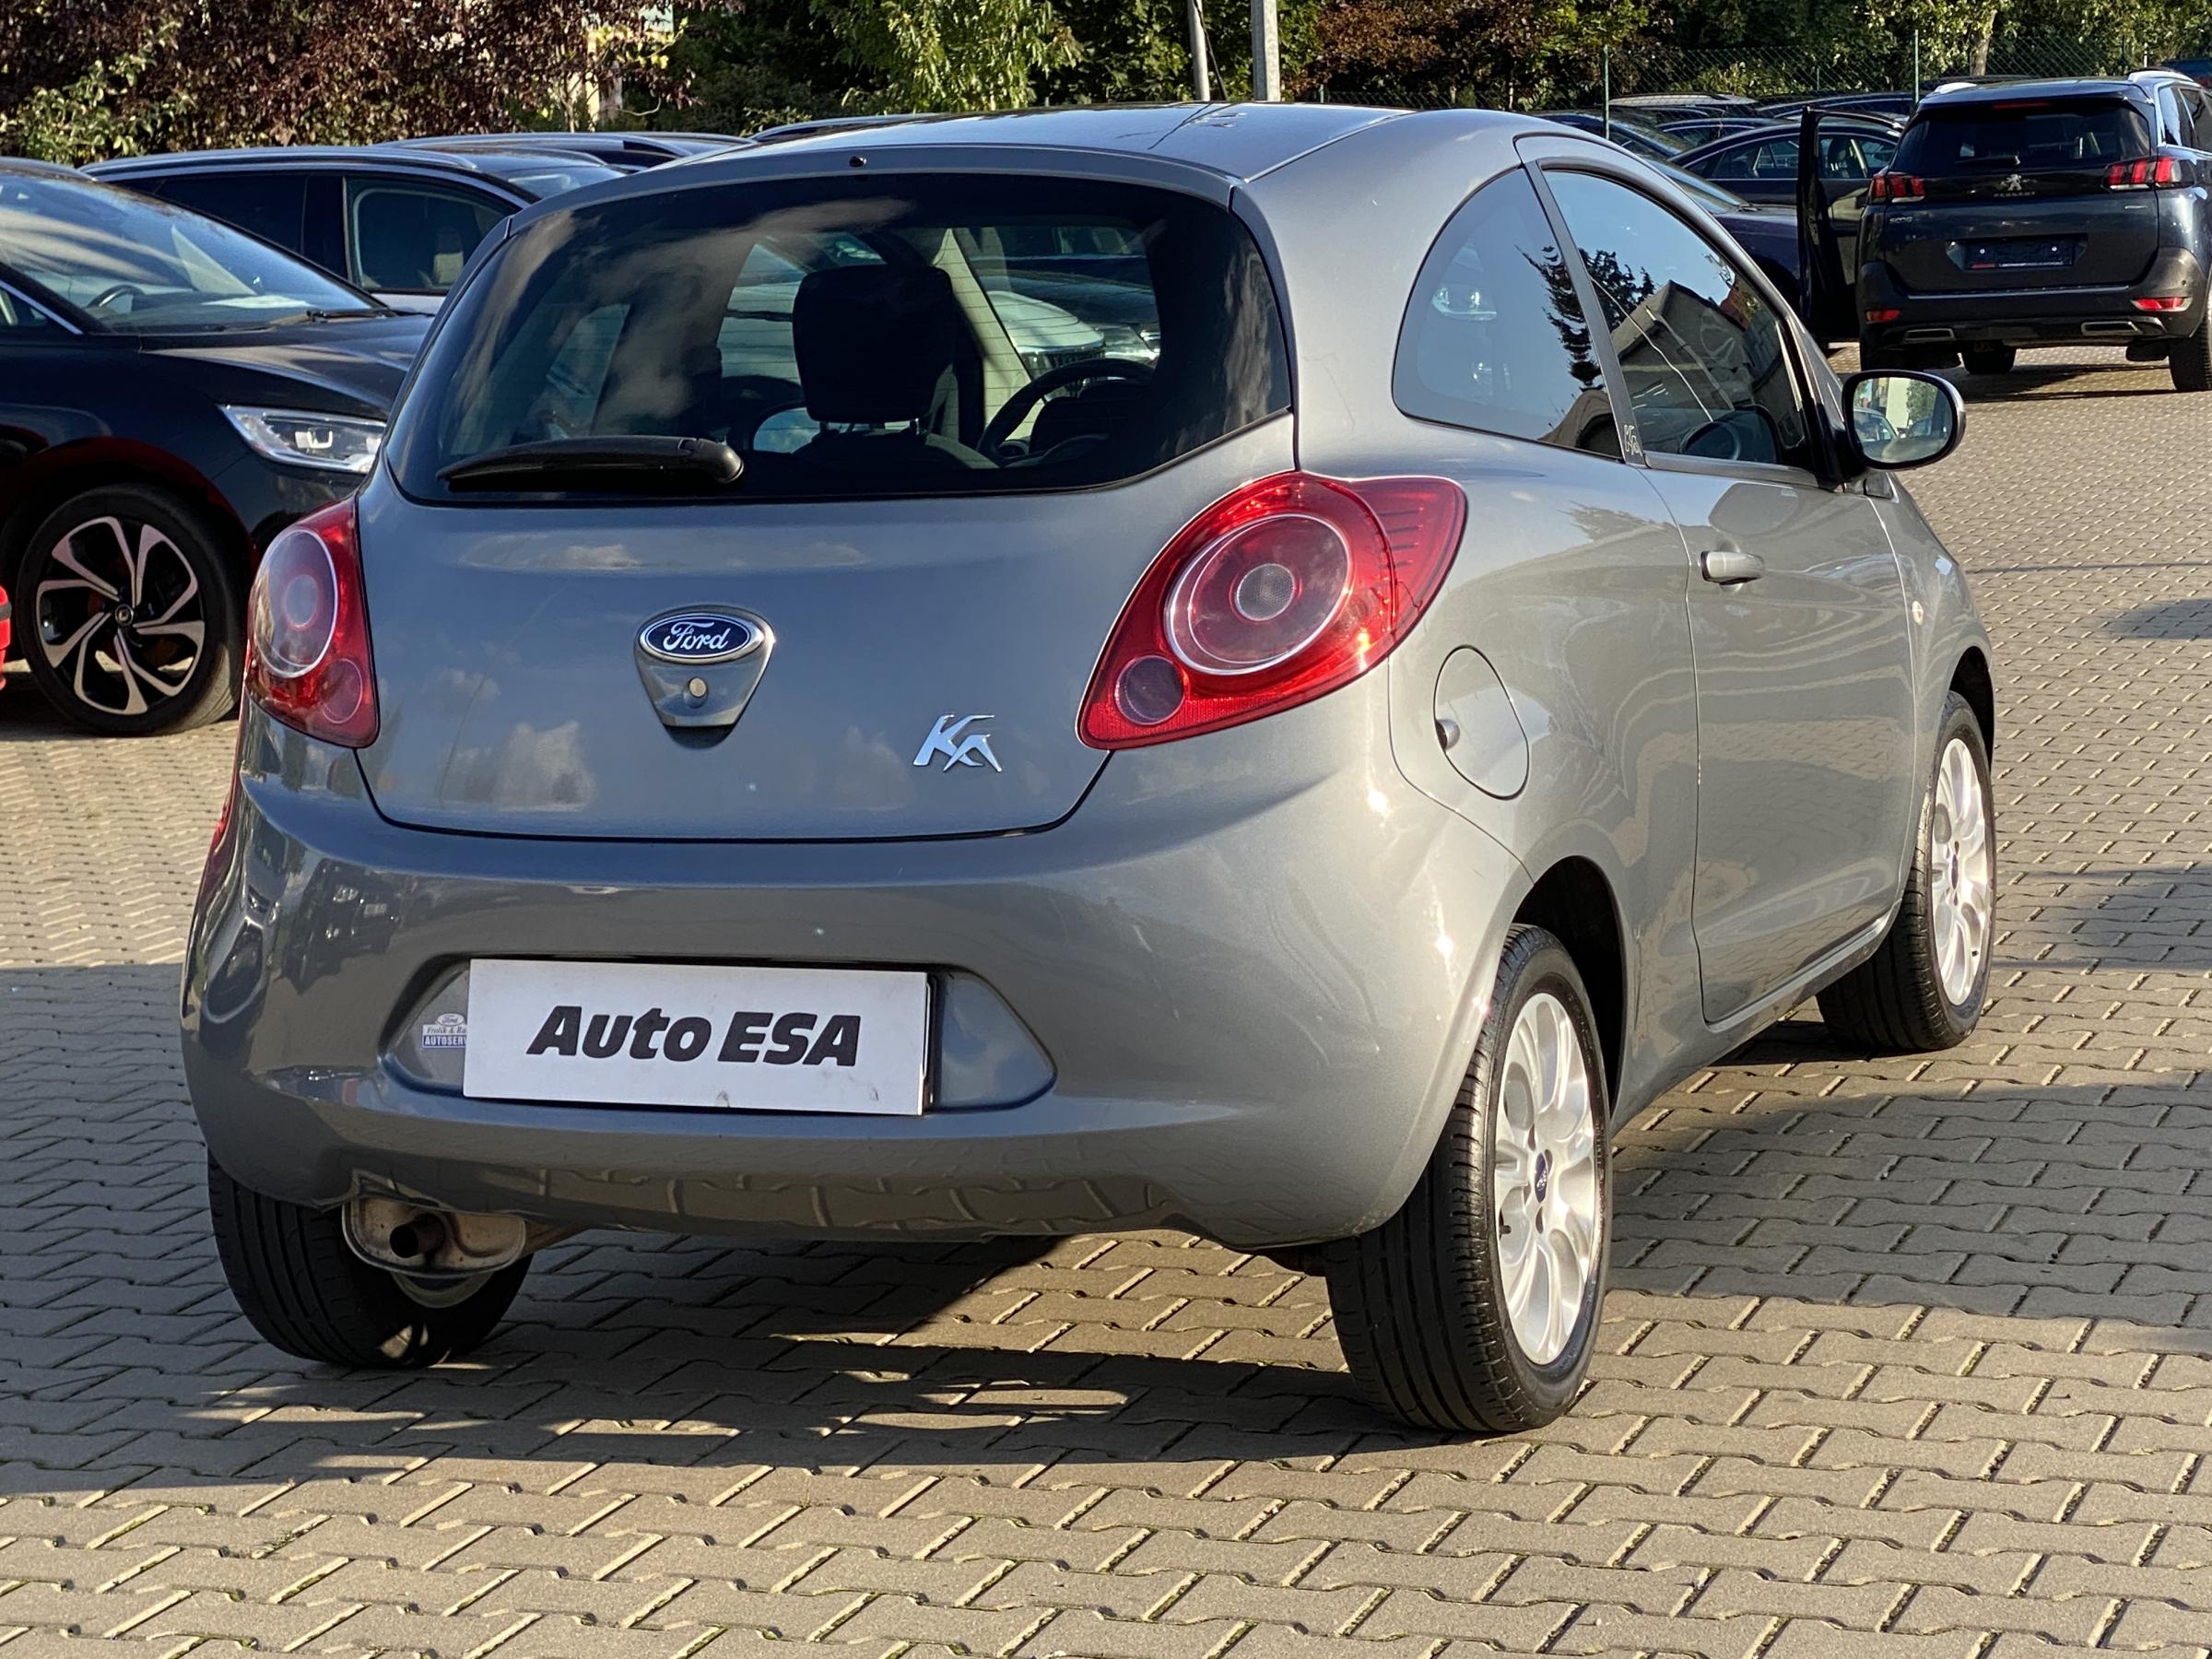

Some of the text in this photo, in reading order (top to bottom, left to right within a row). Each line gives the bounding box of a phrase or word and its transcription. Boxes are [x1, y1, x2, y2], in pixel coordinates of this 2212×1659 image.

[663, 621, 731, 651] Ford
[525, 1004, 862, 1067] Auto ESA
